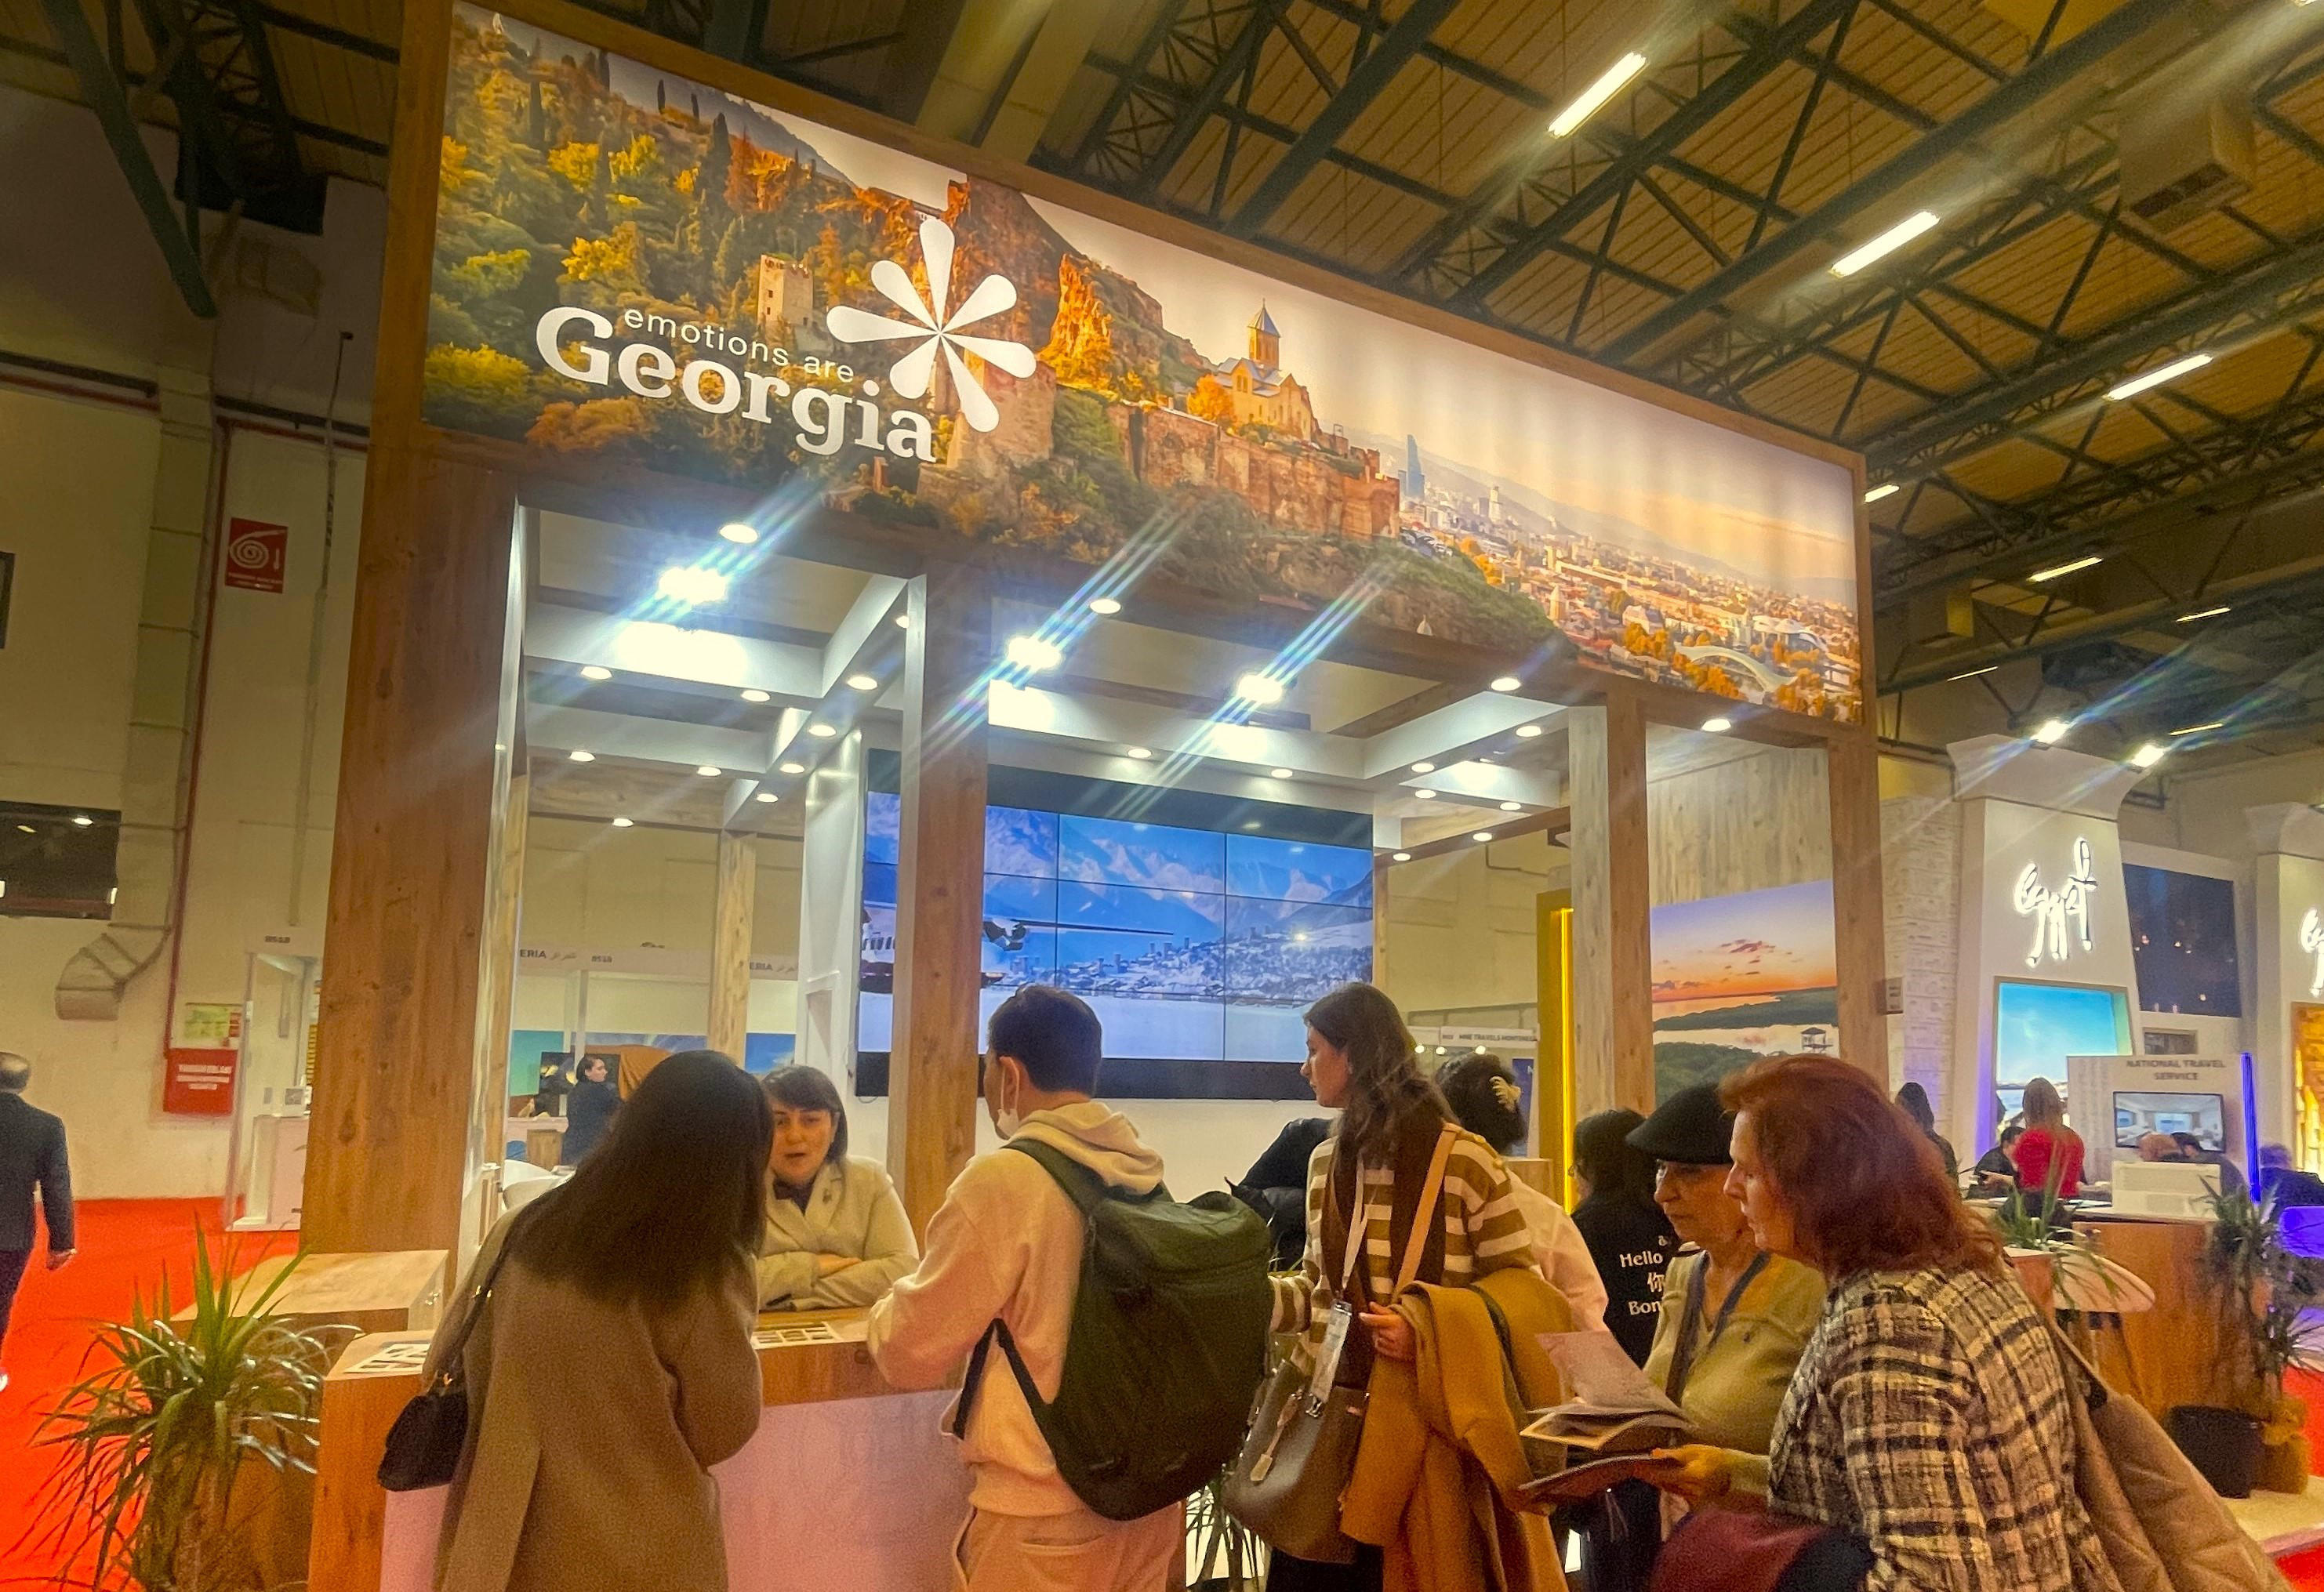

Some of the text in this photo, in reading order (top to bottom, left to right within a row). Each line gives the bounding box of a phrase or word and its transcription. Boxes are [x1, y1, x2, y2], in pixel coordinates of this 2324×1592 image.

[624, 308, 855, 383] emotions are
[536, 306, 936, 463] Georgia
[519, 948, 547, 959] ERIA
[2126, 1059, 2227, 1068] NATIONAL TRAVEL
[2154, 1072, 2199, 1080] SERVICE
[1619, 1250, 1663, 1267] Hello
[1629, 1300, 1661, 1315] Bon
